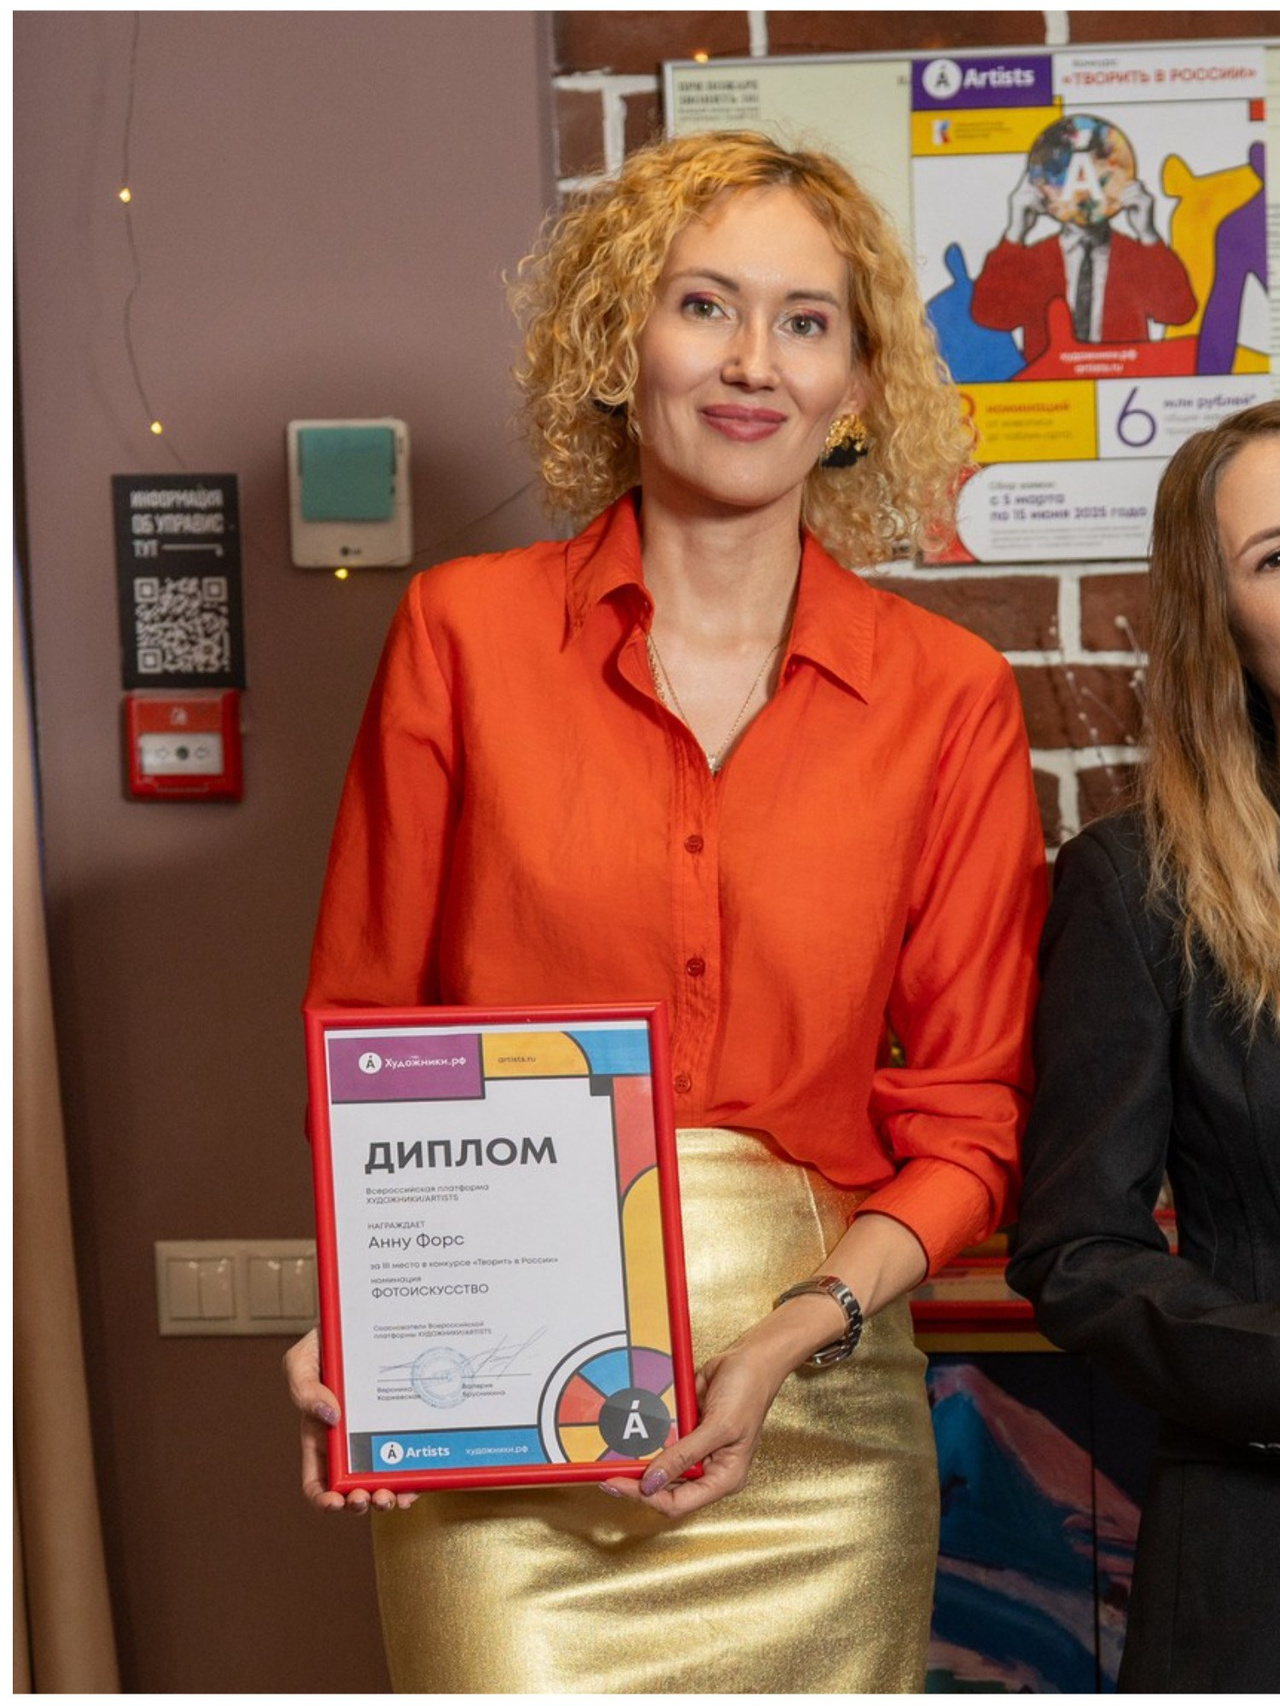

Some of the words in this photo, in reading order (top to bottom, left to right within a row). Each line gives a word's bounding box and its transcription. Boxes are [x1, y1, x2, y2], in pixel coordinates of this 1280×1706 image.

[963, 67, 1035, 89] Artists
[1063, 70, 1150, 86] «ТВОРИТЬ
[1155, 70, 1165, 82] В
[1171, 67, 1257, 82] РОССИИ»
[1117, 386, 1157, 448] 6
[1074, 507, 1106, 519] 2025
[133, 539, 159, 558] ТУТ
[384, 1056, 467, 1069] Художники.рф
[498, 1055, 536, 1063] artists.ru
[364, 1137, 558, 1175] ДИПЛОМ
[365, 1186, 436, 1197] Всероссийская
[437, 1184, 489, 1194] платформа
[368, 1221, 425, 1230] НАГРАЖДАЕТ
[368, 1236, 412, 1251] Анну
[416, 1233, 465, 1249] Форс
[391, 1261, 420, 1269] место
[429, 1259, 471, 1269] конкурсе
[473, 1258, 513, 1266] «Творить
[370, 1276, 422, 1285] номинация
[372, 1283, 489, 1298] ФОТОИСКУССТВО
[405, 1445, 450, 1458] Artists
